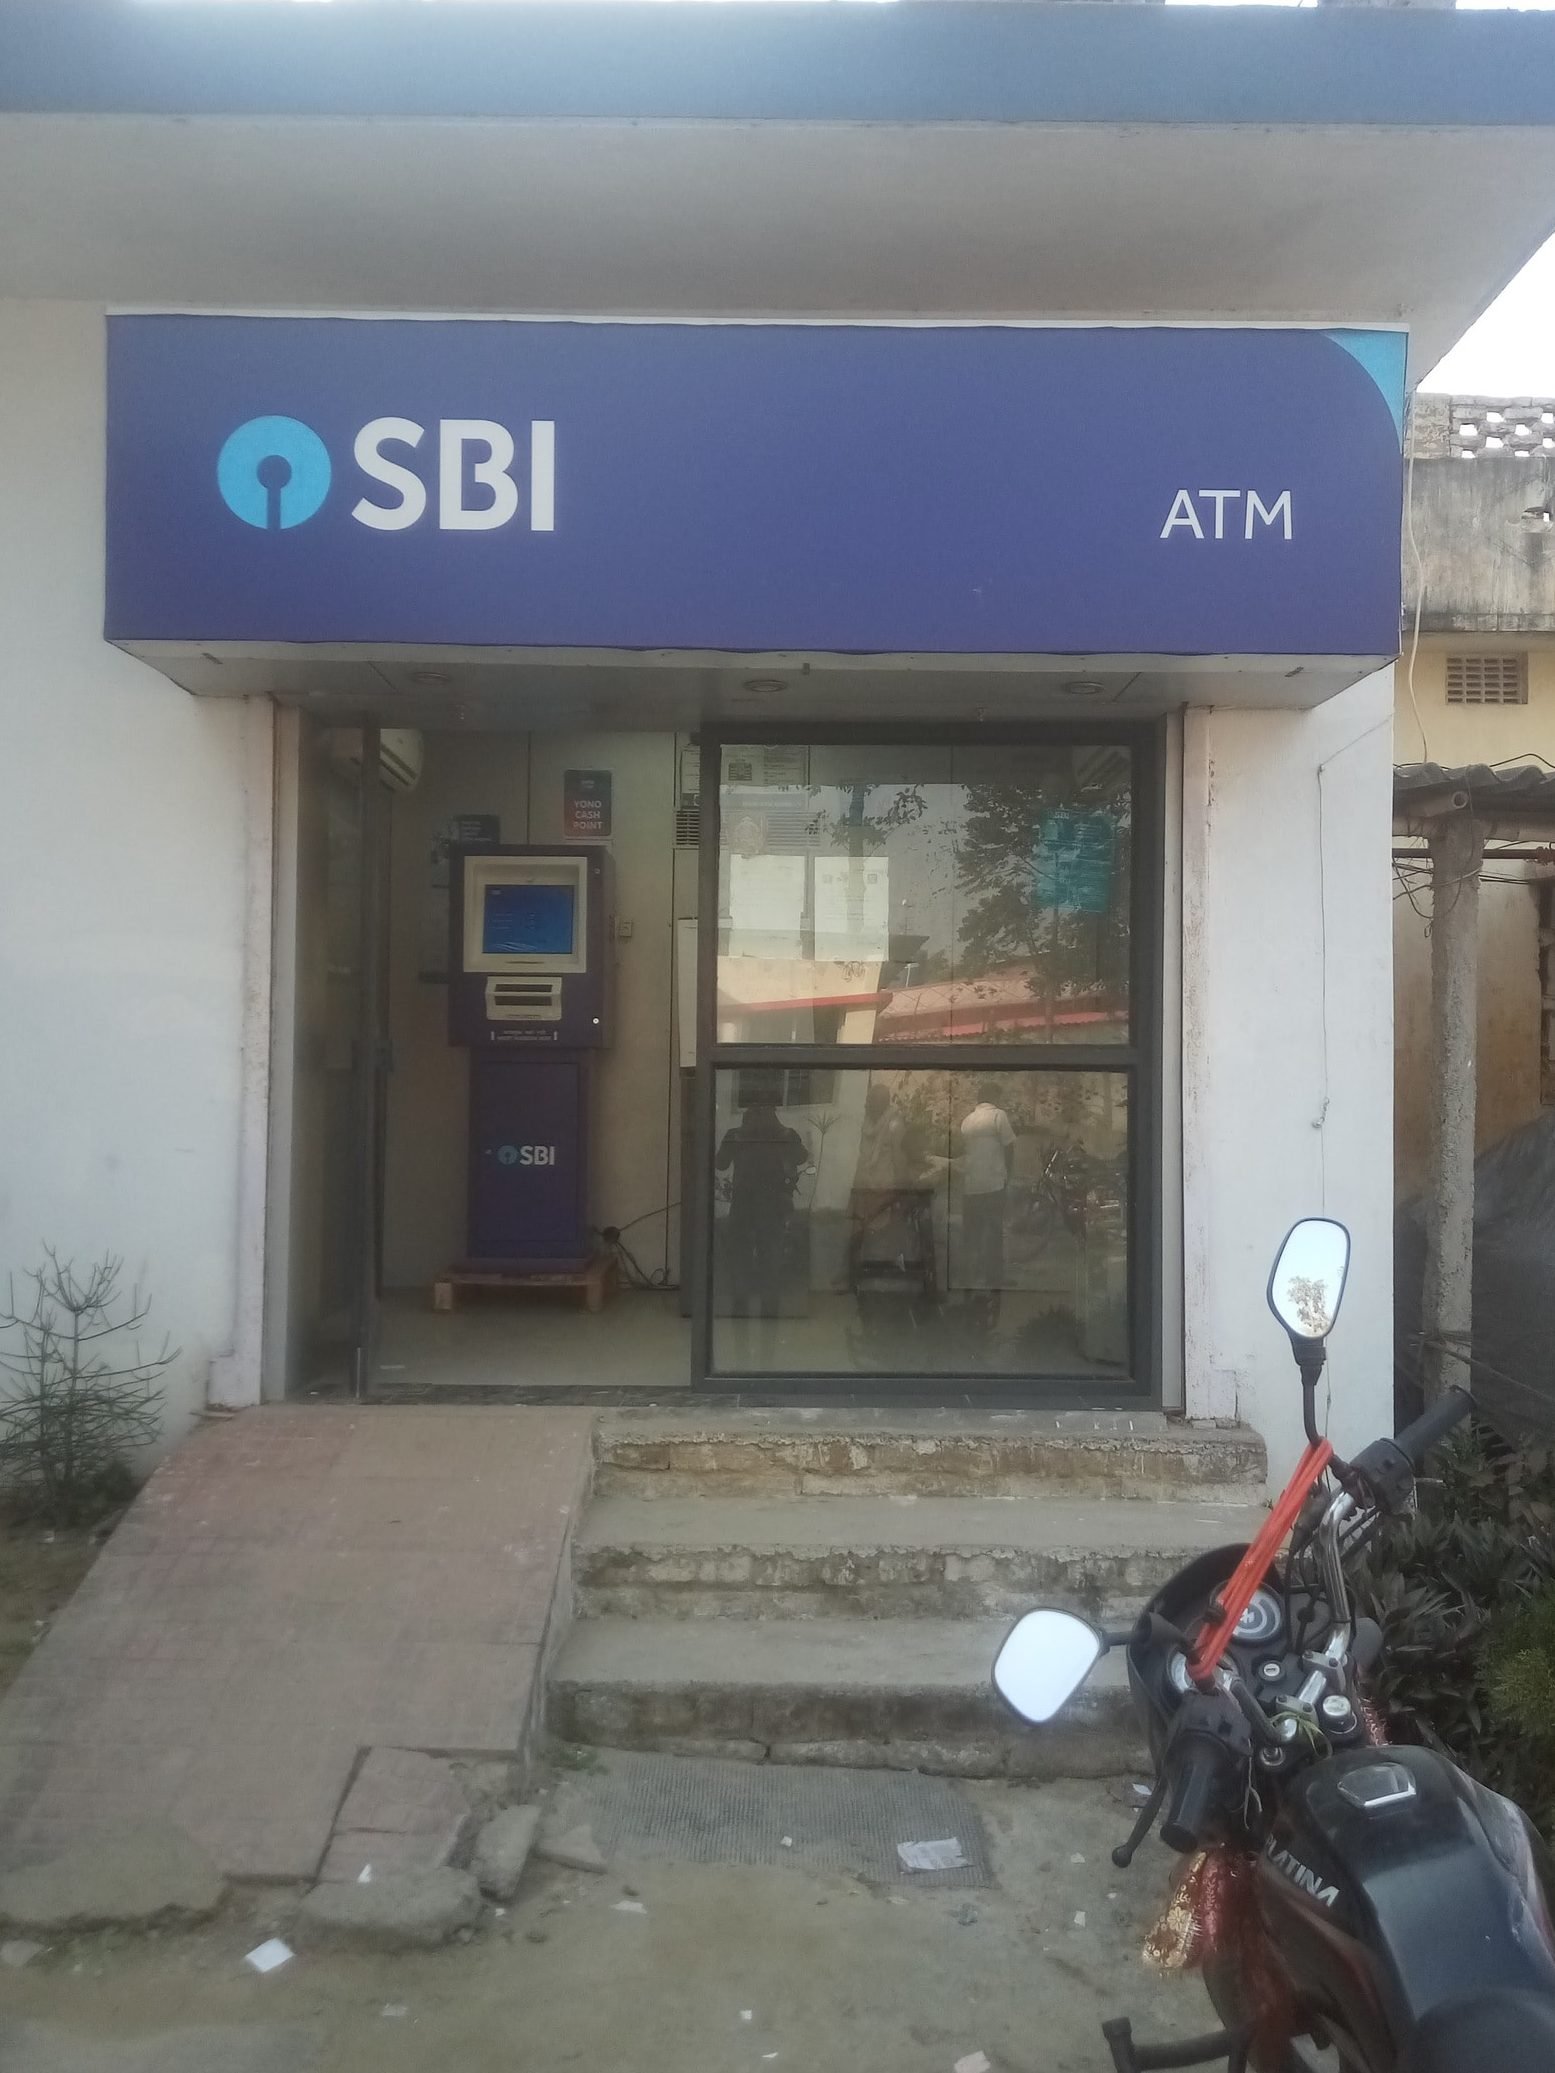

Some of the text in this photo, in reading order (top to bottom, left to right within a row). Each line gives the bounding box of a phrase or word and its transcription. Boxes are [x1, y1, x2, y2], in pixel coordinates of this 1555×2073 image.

[352, 417, 555, 531] SBI
[1160, 489, 1292, 540] ATM
[574, 800, 602, 808] YONO
[575, 810, 601, 819] CASH
[573, 821, 603, 829] POINT
[519, 1145, 556, 1166] SBI
